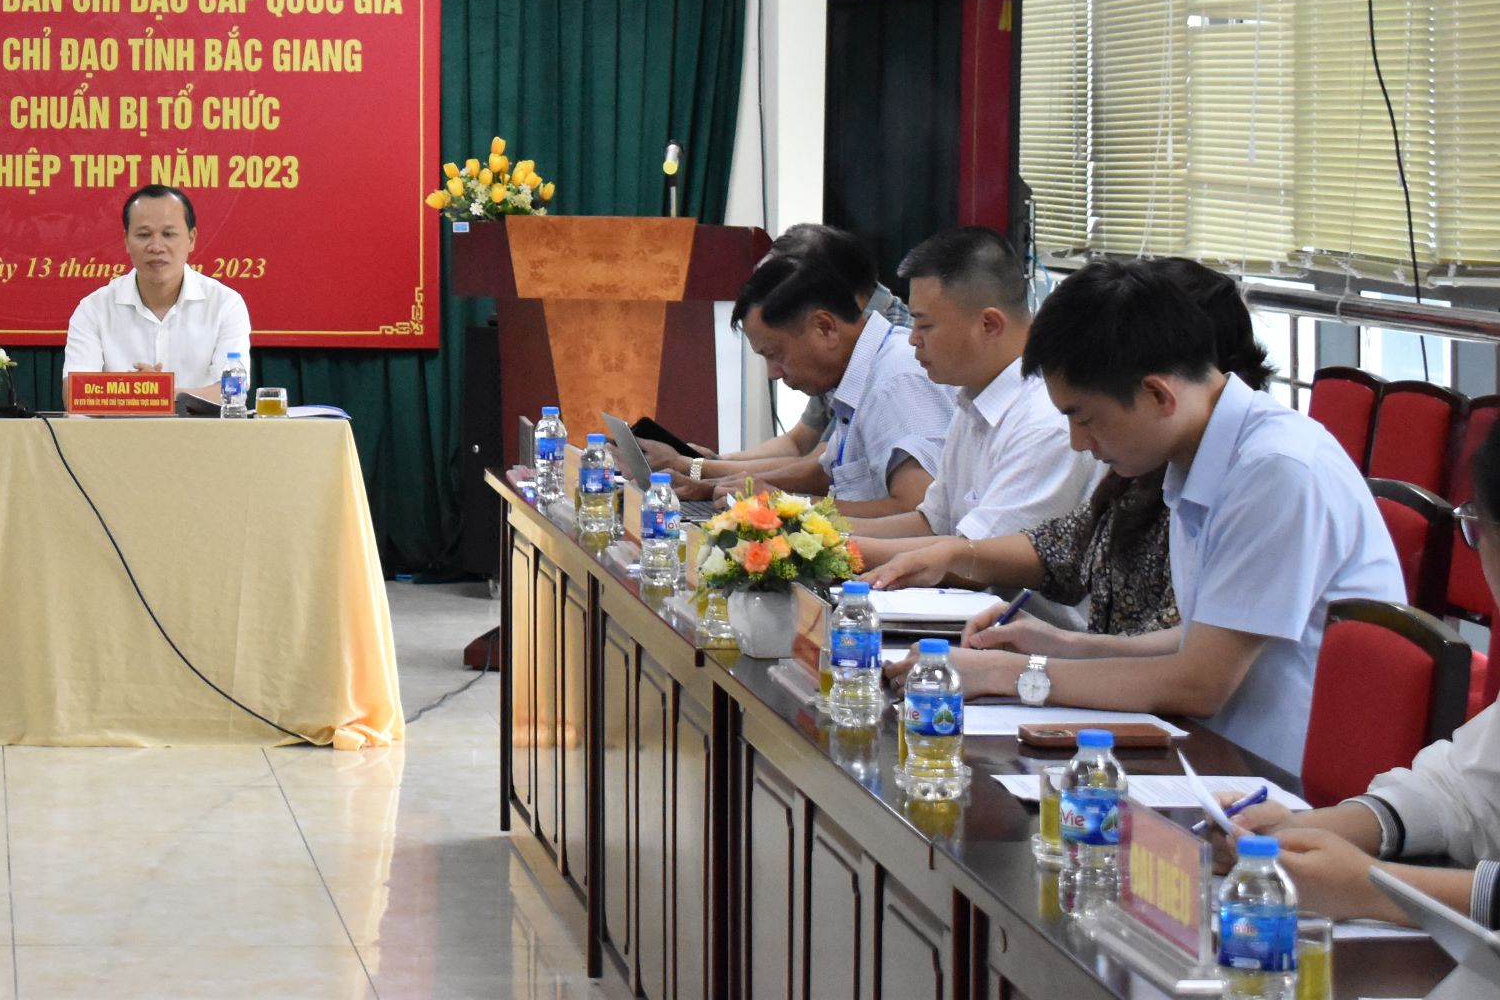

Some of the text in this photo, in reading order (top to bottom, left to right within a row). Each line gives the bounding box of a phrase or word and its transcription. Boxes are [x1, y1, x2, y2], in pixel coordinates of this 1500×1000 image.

[3, 26, 52, 72] CHỈ
[60, 37, 120, 78] ĐẠO
[129, 27, 196, 72] TỈNH
[204, 25, 263, 73] BẮC
[273, 38, 363, 73] GIANG
[10, 83, 110, 130] CHUẨN
[119, 96, 149, 137] BỊ
[157, 82, 194, 131] TỔ
[202, 92, 281, 131] CHỨC
[70, 154, 142, 188] THPT
[151, 147, 220, 188] NĂM
[228, 155, 300, 189] 2023
[26, 257, 53, 278] 13
[58, 257, 126, 281] tháng
[211, 257, 268, 279] 2023
[133, 381, 159, 394] SƠN
